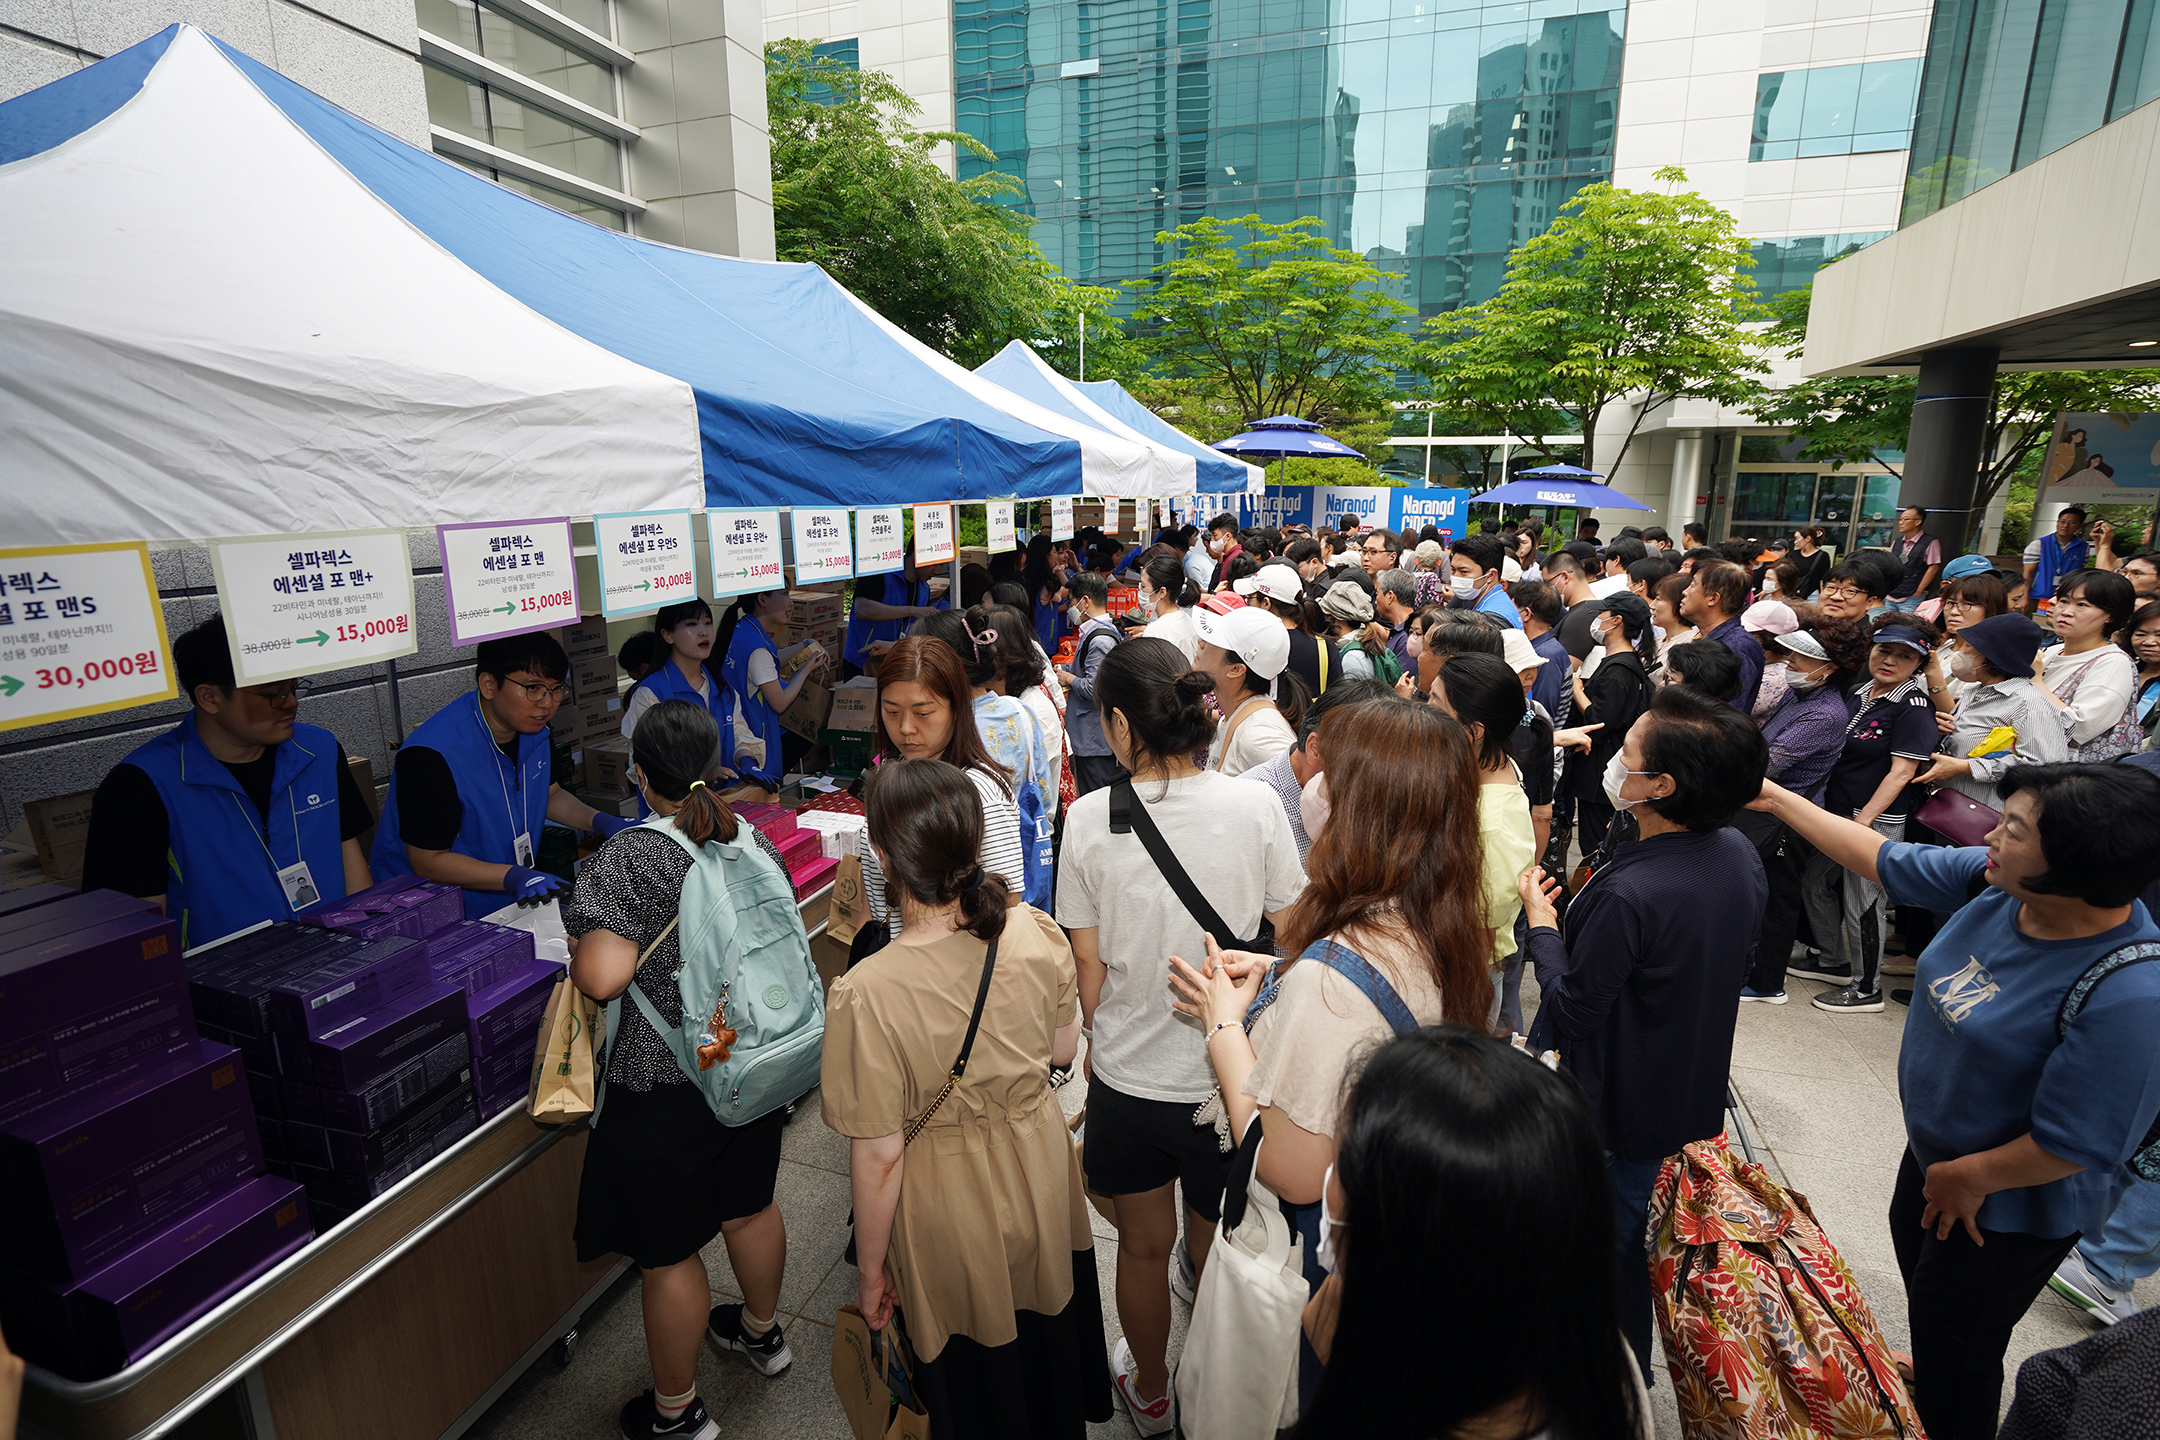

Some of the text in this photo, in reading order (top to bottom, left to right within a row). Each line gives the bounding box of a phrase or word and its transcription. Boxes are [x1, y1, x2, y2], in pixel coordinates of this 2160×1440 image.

[1326, 493, 1377, 518] Narangd
[1402, 494, 1456, 521] Narangd
[630, 523, 663, 538] 셀파렉스
[733, 519, 758, 531] 셀파렉스
[489, 535, 534, 552] 셀파렉스
[618, 537, 678, 555] 에센셜 포 우먼S
[725, 533, 744, 545] 에센셜
[746, 533, 752, 543] 포
[287, 549, 353, 571] 셀파렉스
[482, 551, 545, 571] 에센셜 포 맨
[825, 555, 850, 568] 15,000원
[881, 549, 902, 561] 15,000원
[750, 562, 780, 578] 15,000원
[0, 571, 61, 597] 렉스
[273, 569, 374, 594] 에센셜 포 맨+
[653, 571, 692, 590] 30,000원
[22, 601, 49, 621] 포
[56, 596, 97, 618] 맨S
[272, 591, 384, 613] 22비타민과 미네랄, 테아닌까지!!
[520, 589, 573, 613] 15,000원
[296, 604, 368, 621] 시니어남성용 30일분
[3, 623, 114, 646] 미네랄, 테아닌까지!!
[336, 613, 409, 643] 15,000원
[0, 643, 70, 663] 성용 90일분
[242, 637, 293, 655] 38,000원
[35, 650, 158, 689] 30,000원
[1938, 1012, 1956, 1035] STYLE
